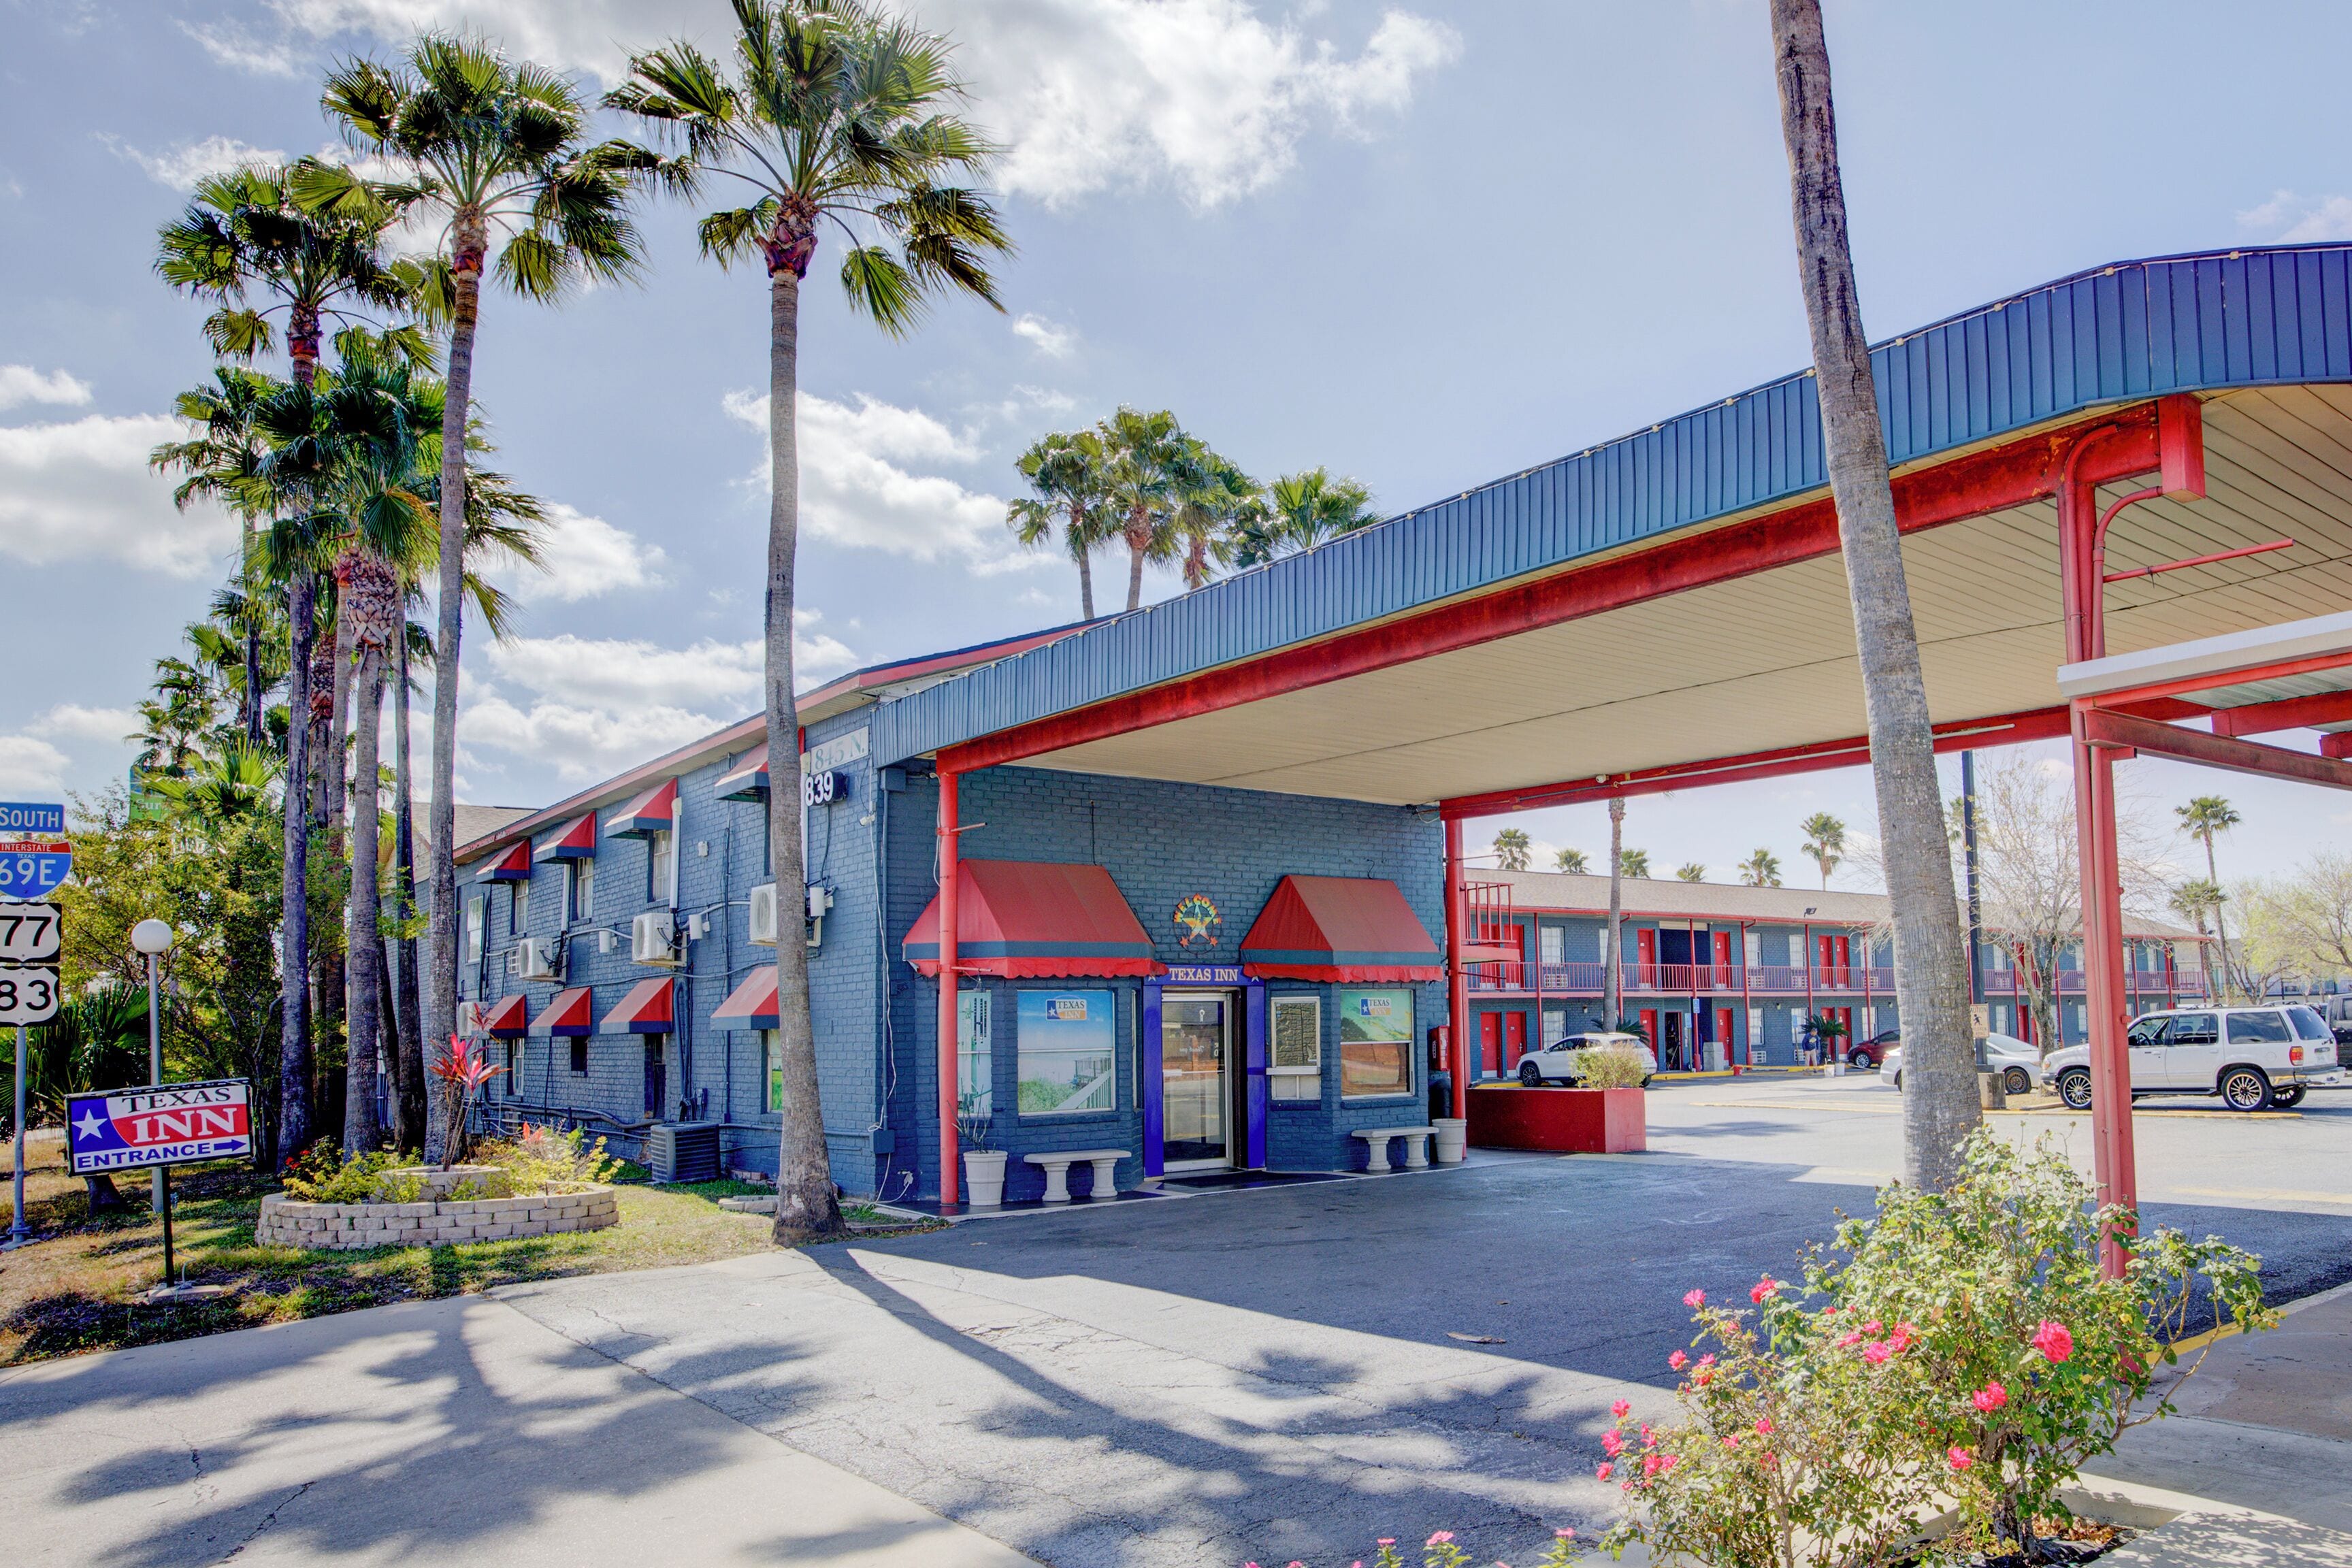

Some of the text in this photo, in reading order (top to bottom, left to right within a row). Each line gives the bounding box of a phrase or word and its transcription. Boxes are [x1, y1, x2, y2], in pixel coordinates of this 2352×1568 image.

[815, 740, 844, 770] 845
[805, 771, 834, 806] 839
[0, 807, 59, 828] SOUTH
[1, 844, 52, 852] INTERSTATE
[0, 858, 56, 885] 69E
[1173, 893, 1222, 925] WELCOME
[0, 916, 52, 947] 77
[1169, 968, 1239, 981] TEXAS INN
[0, 979, 51, 1011] 83
[1057, 1000, 1085, 1009] TEXAS
[1064, 1011, 1081, 1019] INN
[122, 1088, 231, 1113] TEXAS
[133, 1107, 238, 1143] INN
[77, 1143, 212, 1169] ENTRANCE
